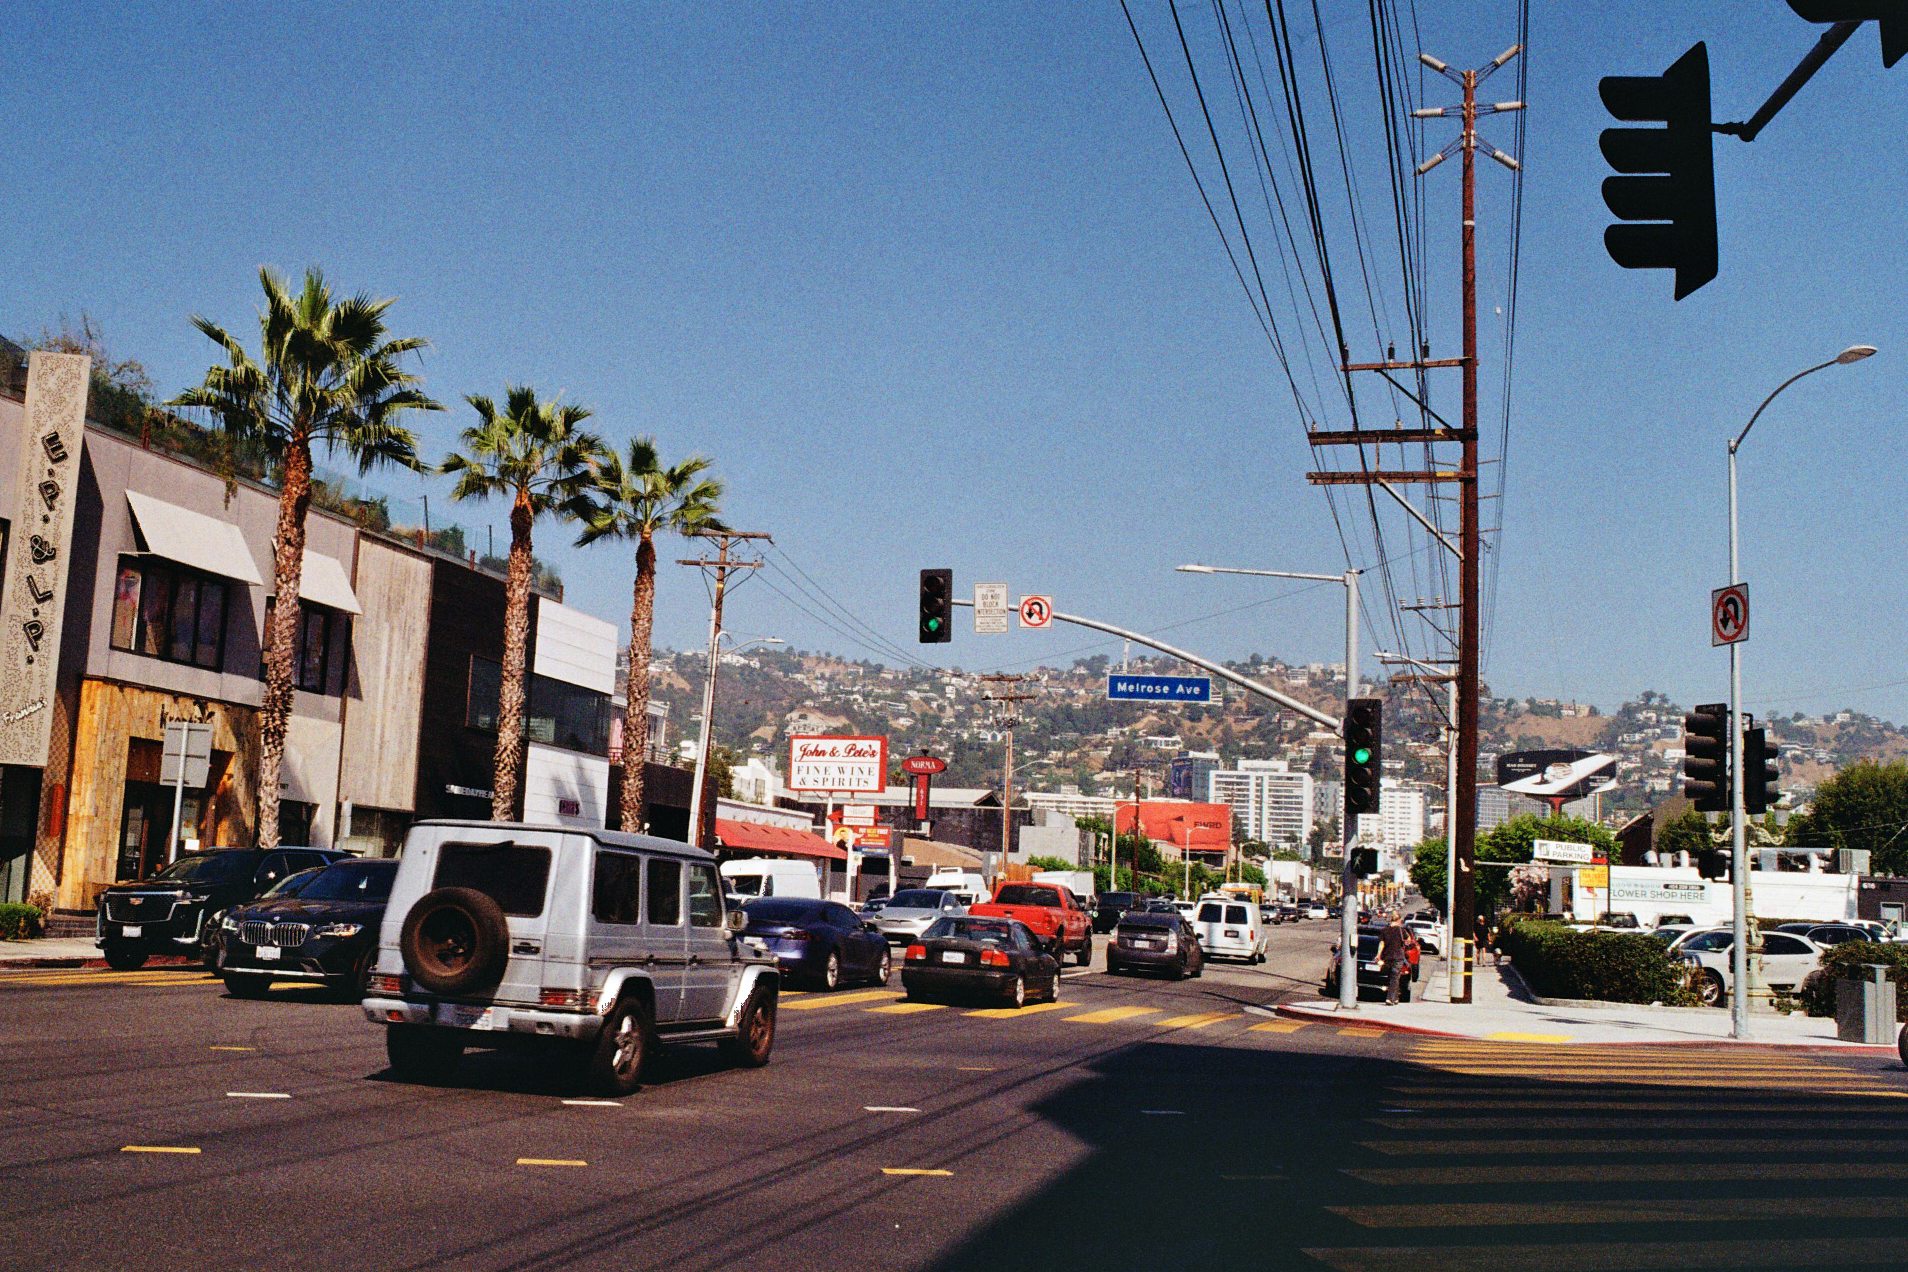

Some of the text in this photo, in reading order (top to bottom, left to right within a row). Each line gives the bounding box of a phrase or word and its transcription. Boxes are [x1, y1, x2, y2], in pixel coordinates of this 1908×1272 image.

[30, 534, 57, 565] &
[1117, 682, 1201, 695] Melrose Ave
[795, 743, 878, 762] John & Pete's
[911, 760, 936, 769] NORMA
[797, 765, 875, 777] FINE WINE
[799, 777, 869, 787] & SPIRITS
[1194, 821, 1223, 829] FWRD
[1555, 843, 1586, 853] PUBLIC
[1552, 850, 1590, 860] PARKING
[1610, 889, 1706, 901] LOWER SHOP HERE
